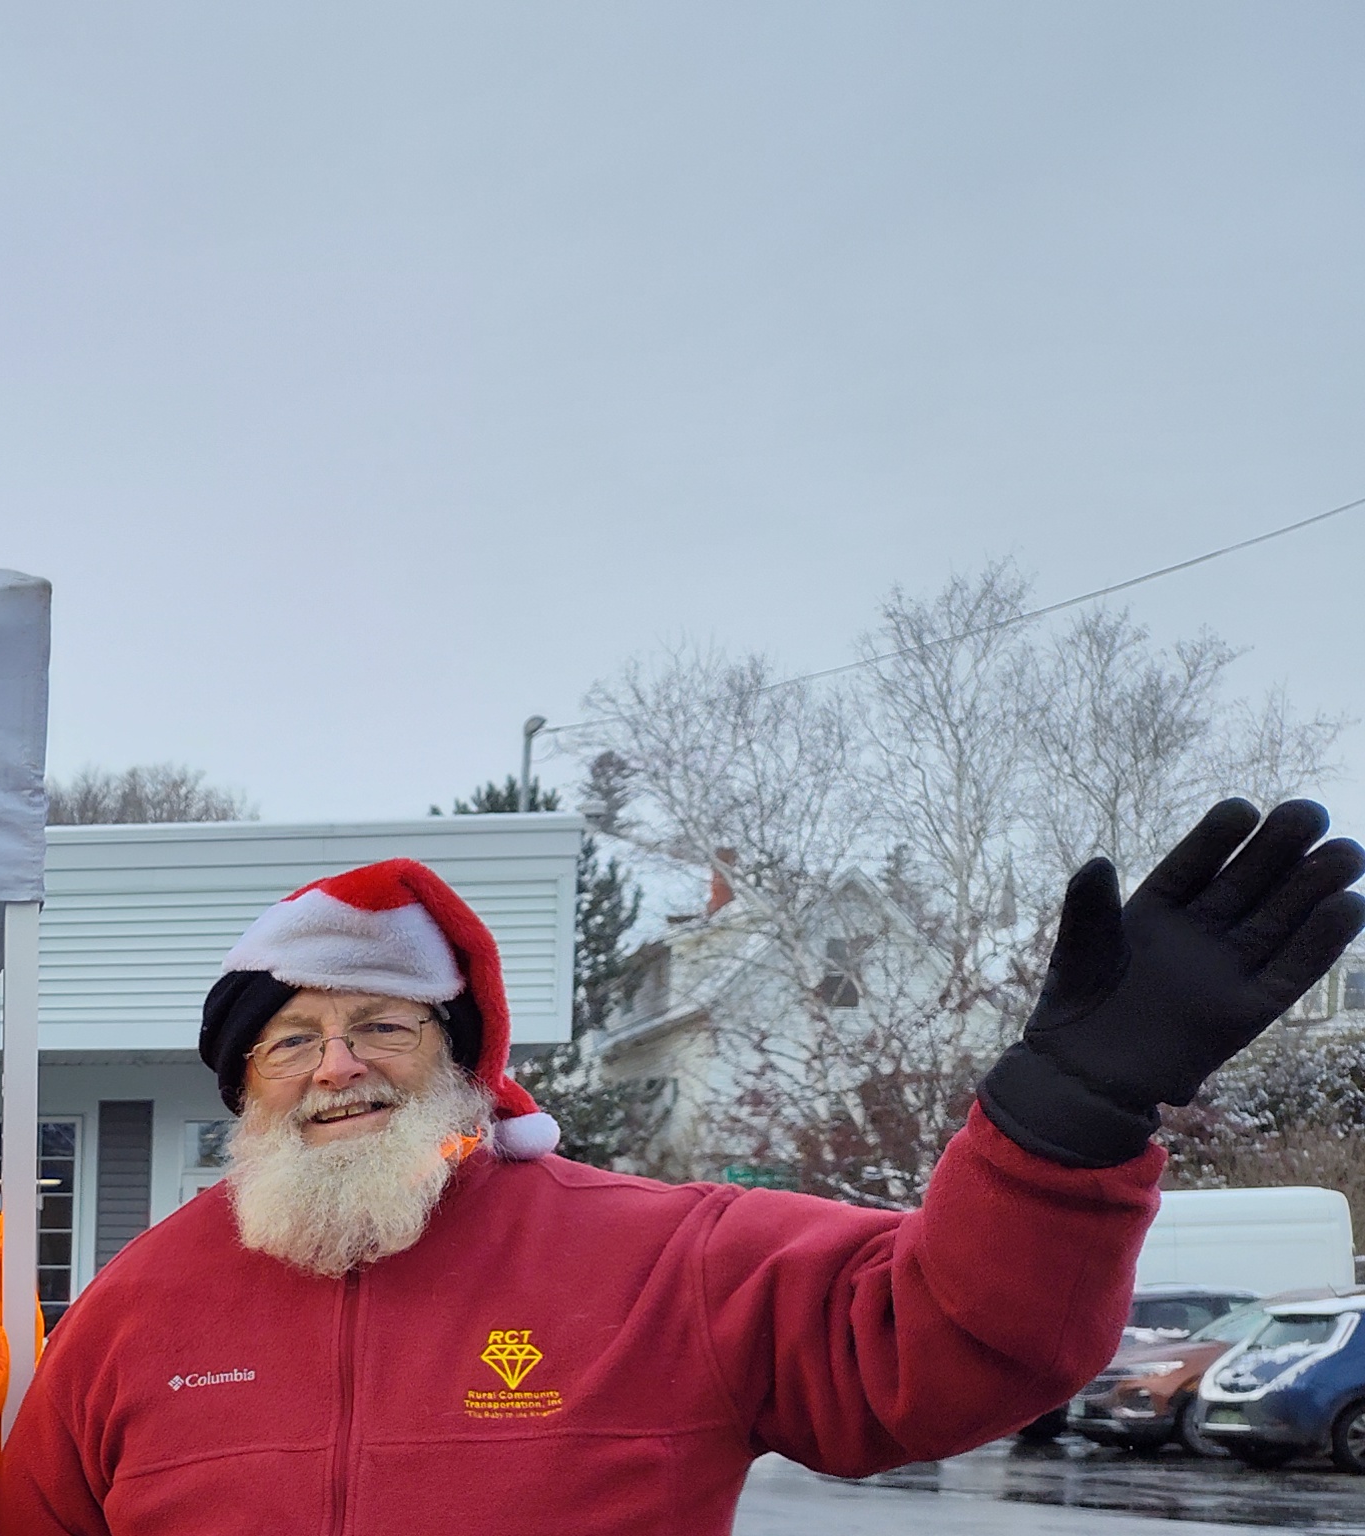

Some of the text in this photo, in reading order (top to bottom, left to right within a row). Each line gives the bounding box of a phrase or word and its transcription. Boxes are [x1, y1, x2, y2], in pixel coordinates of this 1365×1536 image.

[488, 1330, 533, 1344] RCT
[185, 1368, 255, 1388] Columbia
[468, 1390, 560, 1400] Rural Community
